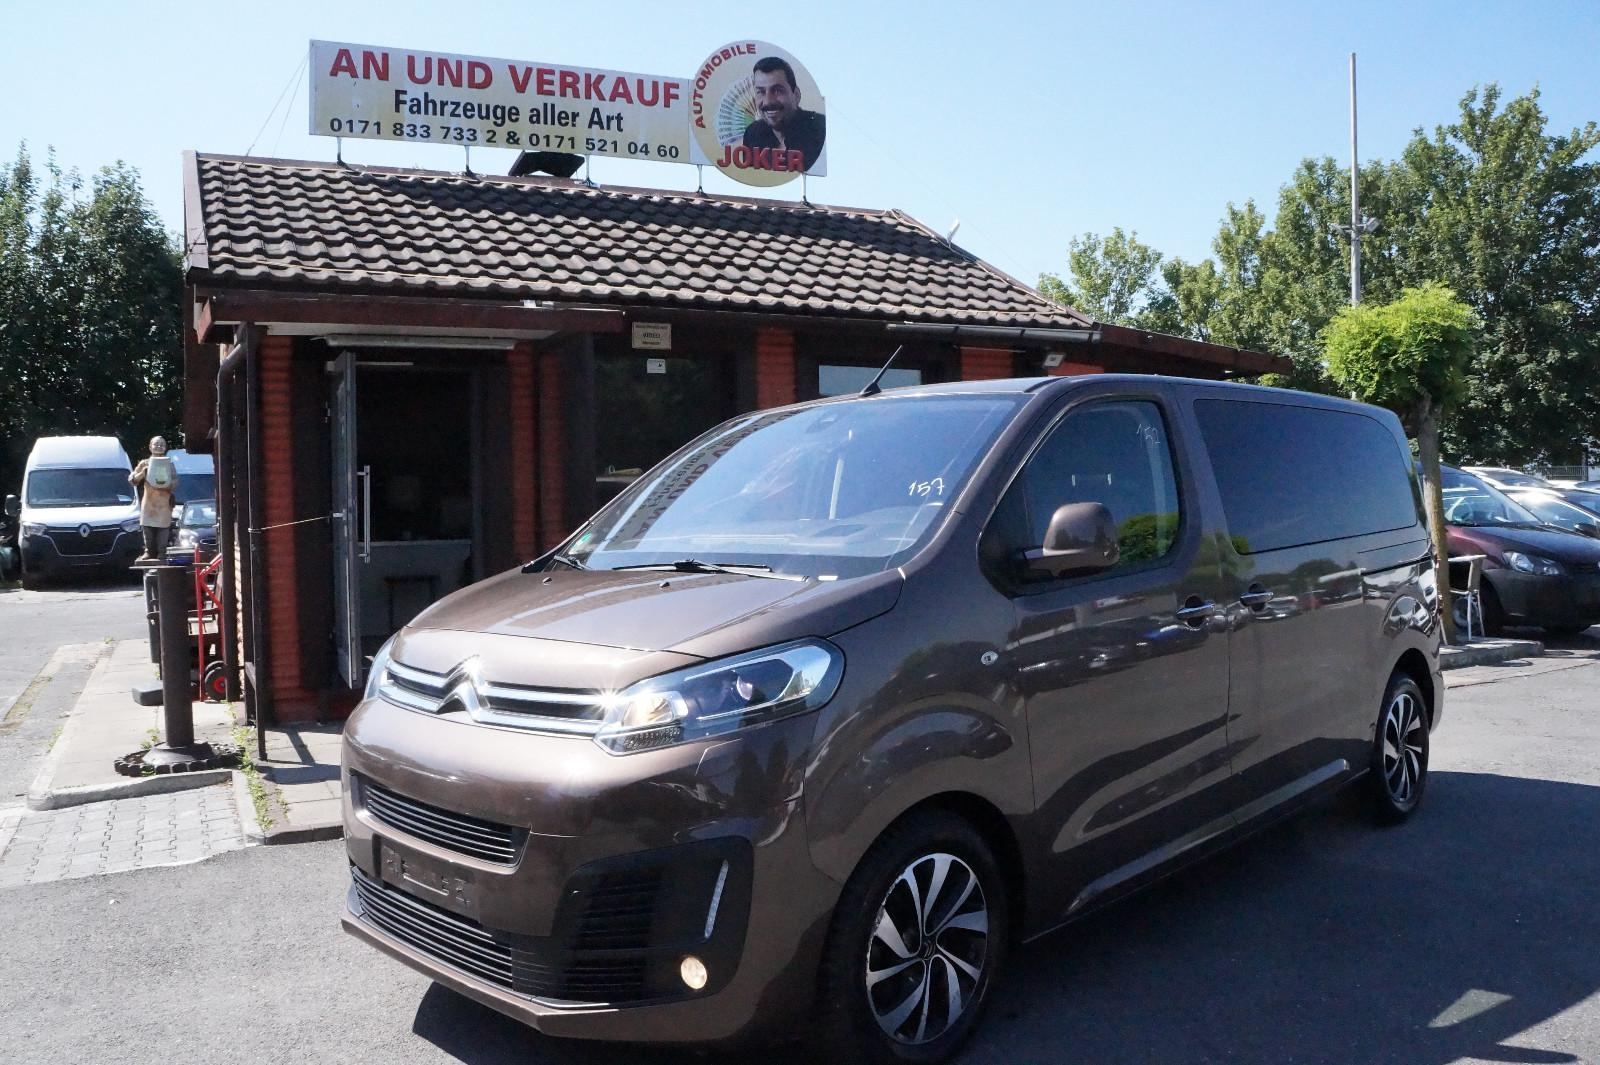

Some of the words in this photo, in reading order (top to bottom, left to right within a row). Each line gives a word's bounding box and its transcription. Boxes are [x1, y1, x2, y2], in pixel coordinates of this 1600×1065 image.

[329, 48, 390, 82] AN
[406, 55, 493, 90] UND
[507, 64, 680, 108] VERKAUF
[692, 43, 757, 129] AUTOMOBILE
[394, 89, 520, 127] Fahrzeuge
[528, 102, 579, 128] aller
[588, 108, 624, 132] Art
[329, 118, 382, 135] 0171
[392, 122, 431, 139] 833
[440, 126, 477, 142] 733
[486, 129, 497, 143] 2
[506, 131, 520, 145] &
[528, 133, 575, 149] 0171
[585, 138, 618, 153] 521
[627, 141, 650, 155] 04
[657, 143, 680, 159] 60
[716, 145, 804, 173] JOKER
[908, 477, 945, 496] 157
